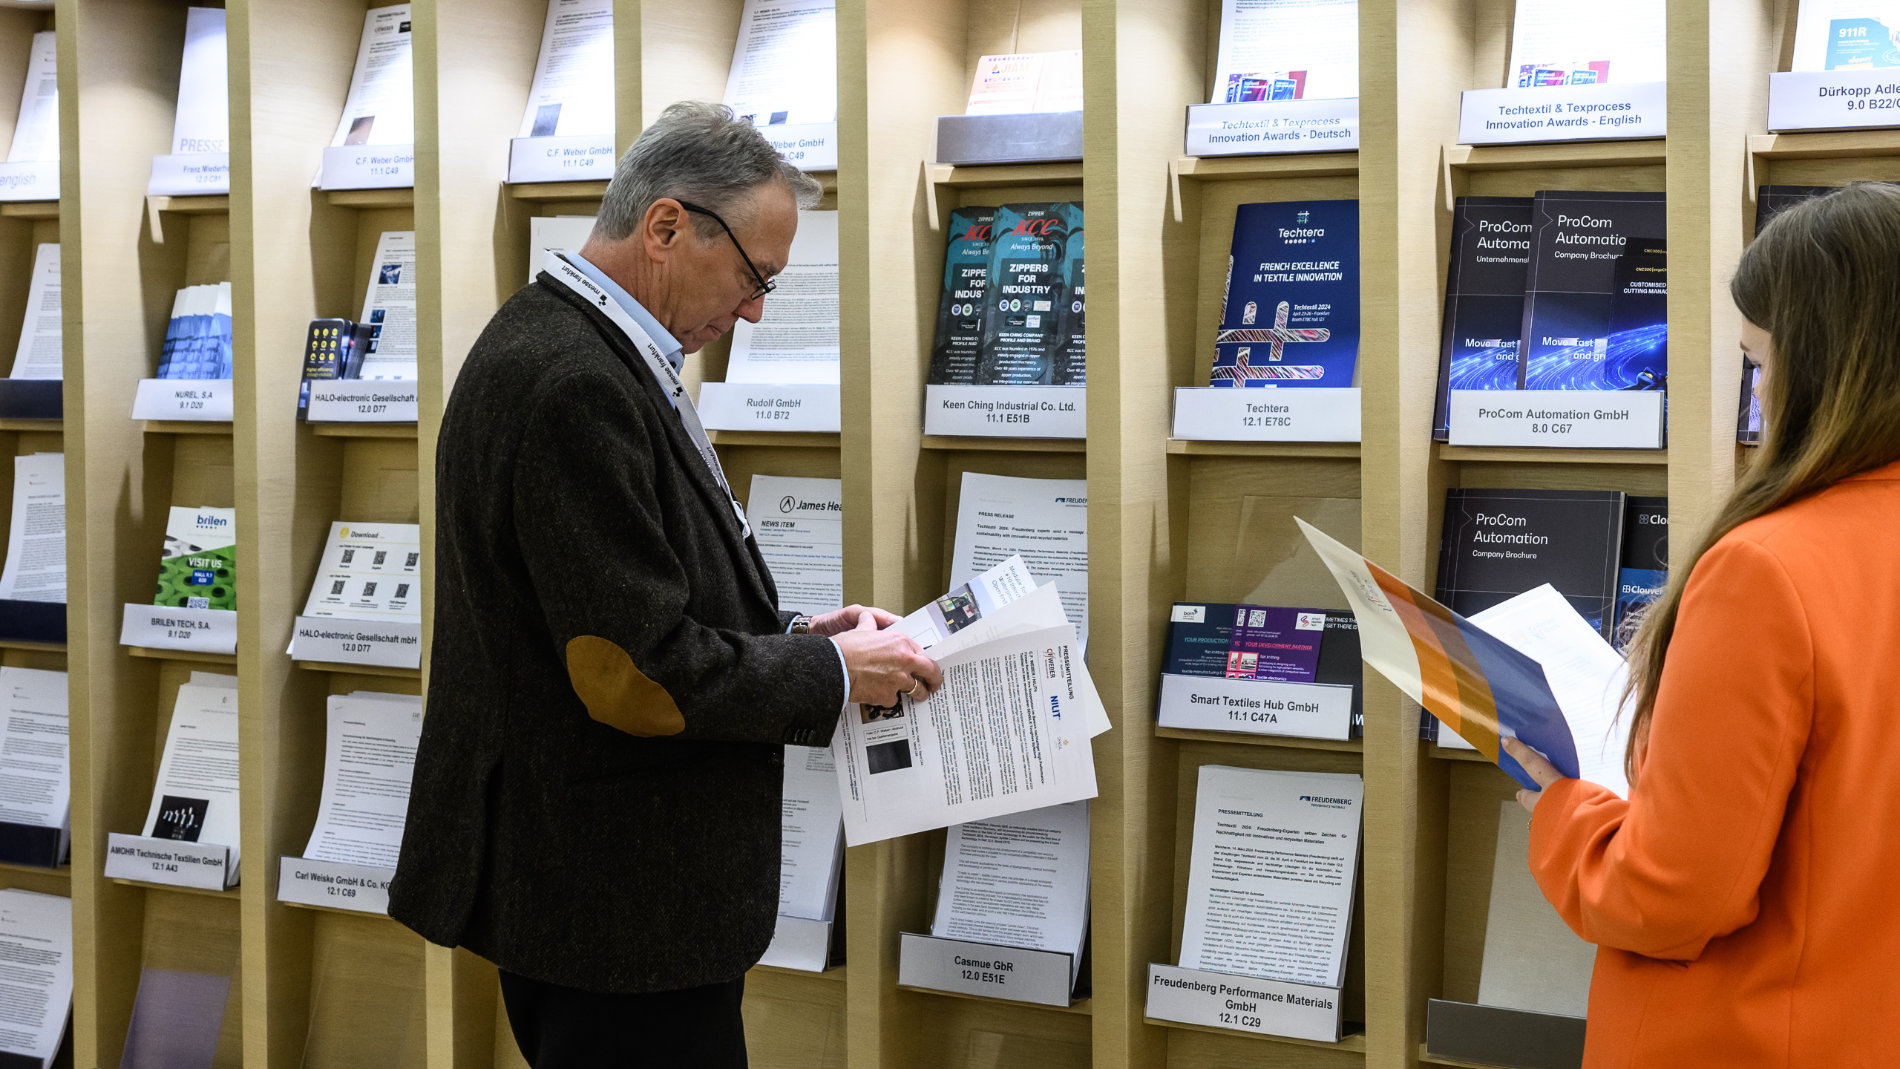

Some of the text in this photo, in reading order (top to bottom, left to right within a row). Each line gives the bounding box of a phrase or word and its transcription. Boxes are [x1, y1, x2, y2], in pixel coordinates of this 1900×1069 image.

[1839, 27, 1867, 38] 911R
[1819, 86, 1871, 98] Dürkopp
[1499, 102, 1632, 116] Techtextil & Texprocess
[1848, 100, 1865, 110] 9.0
[1222, 117, 1340, 130] Techtextil & Texprocess
[1486, 120, 1544, 130] Innovation
[1546, 116, 1588, 127] Awards
[1600, 114, 1642, 126] English
[1208, 133, 1260, 144] Innovation
[1263, 131, 1300, 142] Awards
[1310, 128, 1352, 140] Deutsch
[180, 138, 224, 152] PRESSE
[798, 138, 825, 148] GmbH
[564, 148, 587, 156] Weber
[588, 146, 613, 155] GmbH
[788, 152, 804, 160] C49
[370, 156, 392, 164] Weber
[580, 158, 594, 167] C49
[385, 167, 399, 175] C49
[1479, 220, 1532, 233] ProCom
[1558, 214, 1612, 228] ProCom
[1011, 219, 1058, 236] KCC
[1278, 227, 1324, 238] Techtera
[1556, 232, 1626, 246] Automatio
[1032, 243, 1053, 251] Beyond
[1554, 250, 1588, 262] Company
[1010, 264, 1048, 272] ZIPPERS
[1260, 261, 1340, 271] FRENCH EXCELLENCE
[562, 266, 600, 294] messe frankfurt
[1018, 275, 1036, 283] FOR
[1264, 274, 1294, 282] TEXTILE
[1296, 272, 1342, 282] INNOVATION
[955, 290, 985, 298] INDUS
[1002, 286, 1050, 294] INDUSTRY
[1465, 338, 1516, 348] Move fast
[1542, 336, 1594, 347] Move fast
[1496, 352, 1514, 361] and
[1574, 351, 1592, 360] and
[648, 344, 679, 386] messe frankfurt
[314, 394, 414, 402] HALO-electronic Gesellschaft
[746, 398, 802, 408] Rudolf GmbH
[358, 405, 387, 413] 12.0 D77
[943, 400, 1076, 412] Keen Ching Industrial Co. Ltd.
[1246, 404, 1289, 412] Techtera
[756, 410, 790, 420] 11.0 B72
[986, 414, 1030, 424] 11.1 E51B
[1479, 408, 1629, 420] ProCom Automation GmbH
[1242, 418, 1291, 426] 12.1 E78C
[1532, 424, 1572, 433] 8.0 C67
[796, 500, 826, 512] James
[197, 514, 228, 526] brilen
[1476, 513, 1527, 526] ProCom
[350, 530, 379, 538] Download
[1474, 530, 1548, 544] Automation
[1472, 550, 1538, 559] Company Brochure
[188, 558, 222, 568] VISIT US
[151, 618, 176, 627] BRILEN
[300, 629, 417, 644] HALO-electronic Gesellschaft mbH
[342, 643, 371, 652] 12.0 D77
[1050, 696, 1061, 719] NILIT
[1190, 694, 1319, 713] Smart Textiles Hub GmbH
[1228, 711, 1278, 724] 11.1 C47A
[1311, 796, 1352, 806] FREUDENBERG
[1218, 808, 1264, 818] PRESSEMITTEILUNG
[110, 846, 222, 867] AMOHR Technische Textilien GmbH
[152, 862, 178, 872] 12.1 A43
[296, 870, 309, 880] Carl
[310, 872, 334, 883] Weiske
[336, 876, 358, 886] GmbH
[360, 878, 365, 887] &
[367, 880, 378, 889] Co.
[327, 886, 356, 898] 12.1 C69
[954, 955, 1014, 972] Casmue GbR
[961, 970, 1006, 984] 12.0 E51E
[1154, 975, 1333, 1010] Freudenberg Performance Materials
[1225, 999, 1257, 1013] GmbH
[1218, 1012, 1261, 1028] 12.1 C29
